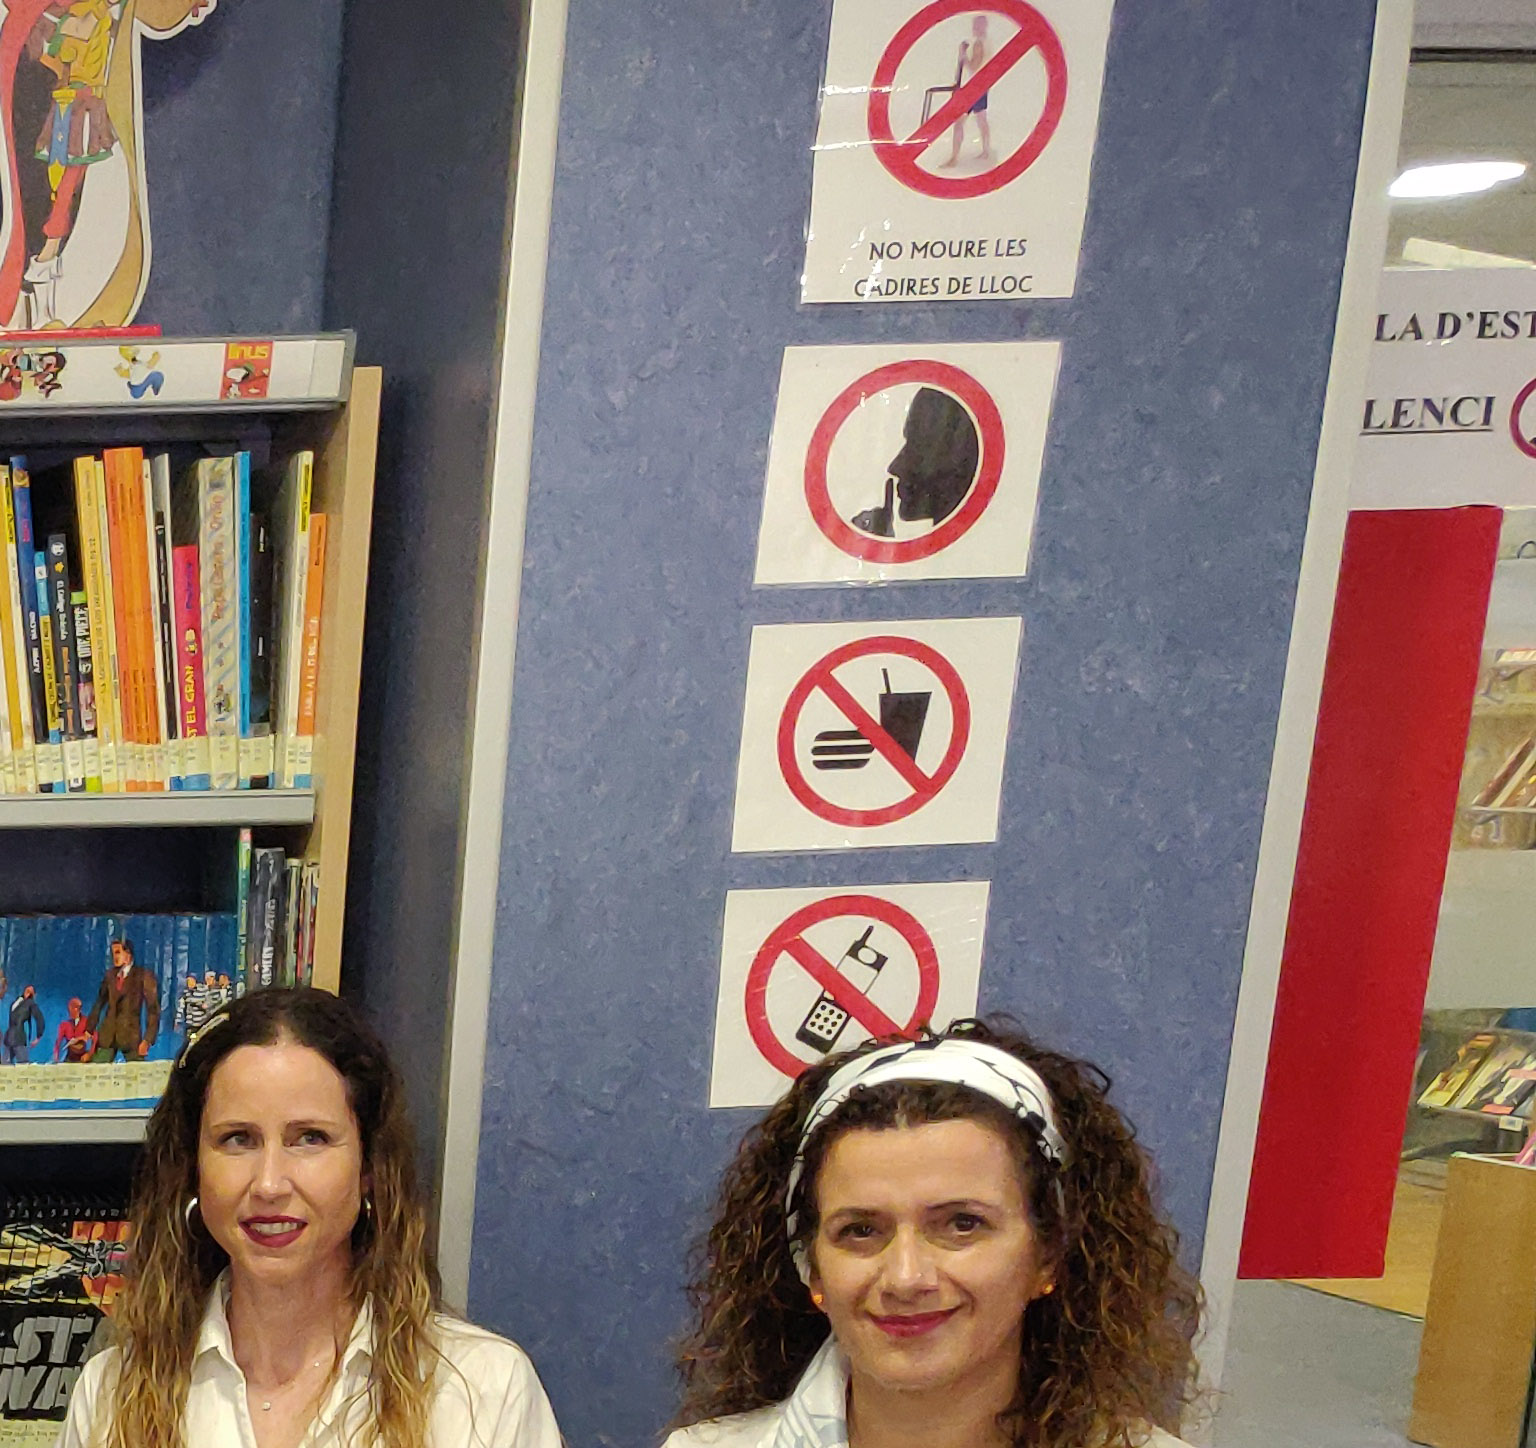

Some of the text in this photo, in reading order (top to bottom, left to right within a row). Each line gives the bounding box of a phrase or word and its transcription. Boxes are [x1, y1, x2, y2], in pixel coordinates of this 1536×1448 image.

[869, 238, 1028, 260] NO MOURE LES
[854, 275, 1033, 297] CADIRES DE LLOC
[1374, 313, 1423, 342] LA
[1360, 396, 1496, 432] LENCI
